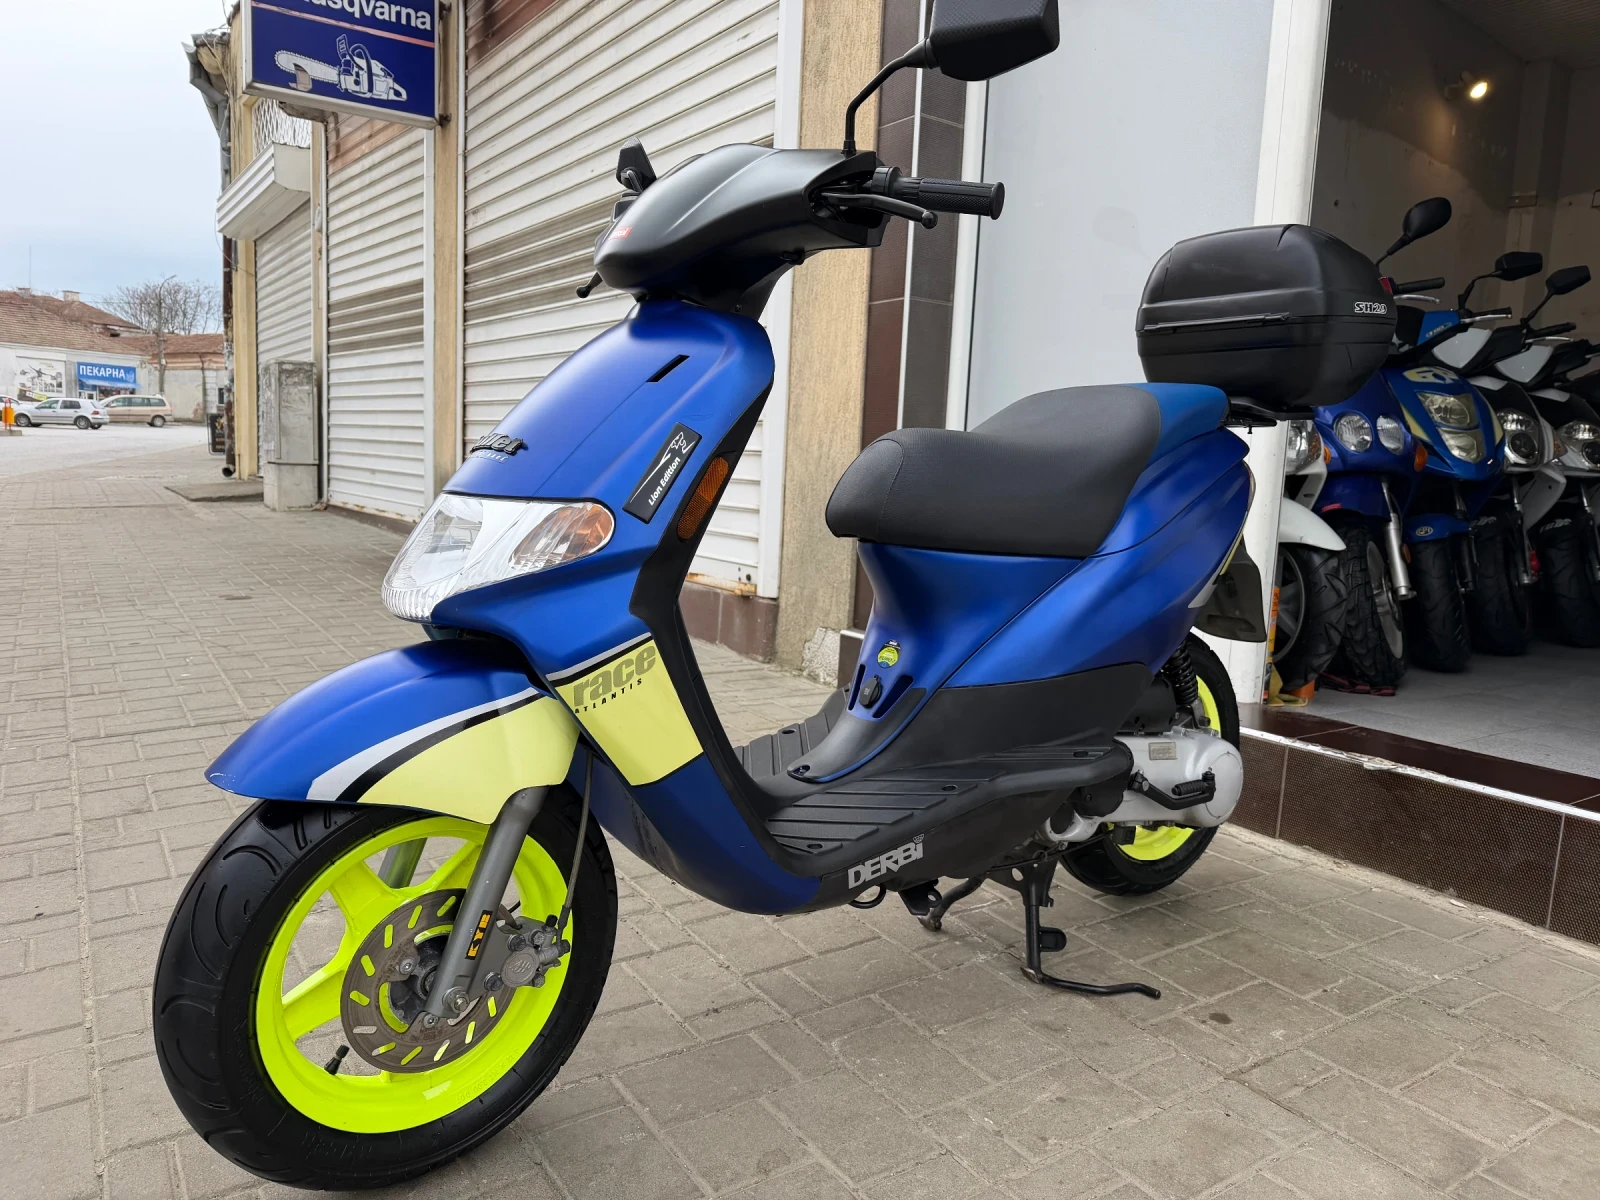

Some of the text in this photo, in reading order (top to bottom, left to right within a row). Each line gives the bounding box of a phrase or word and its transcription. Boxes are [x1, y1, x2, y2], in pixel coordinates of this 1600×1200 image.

[80, 365, 126, 379] ПЕКАРНА
[648, 457, 681, 506] Lion Edition
[573, 645, 656, 707] race
[574, 678, 642, 714] ATLANTIS
[467, 913, 491, 957] KYB
